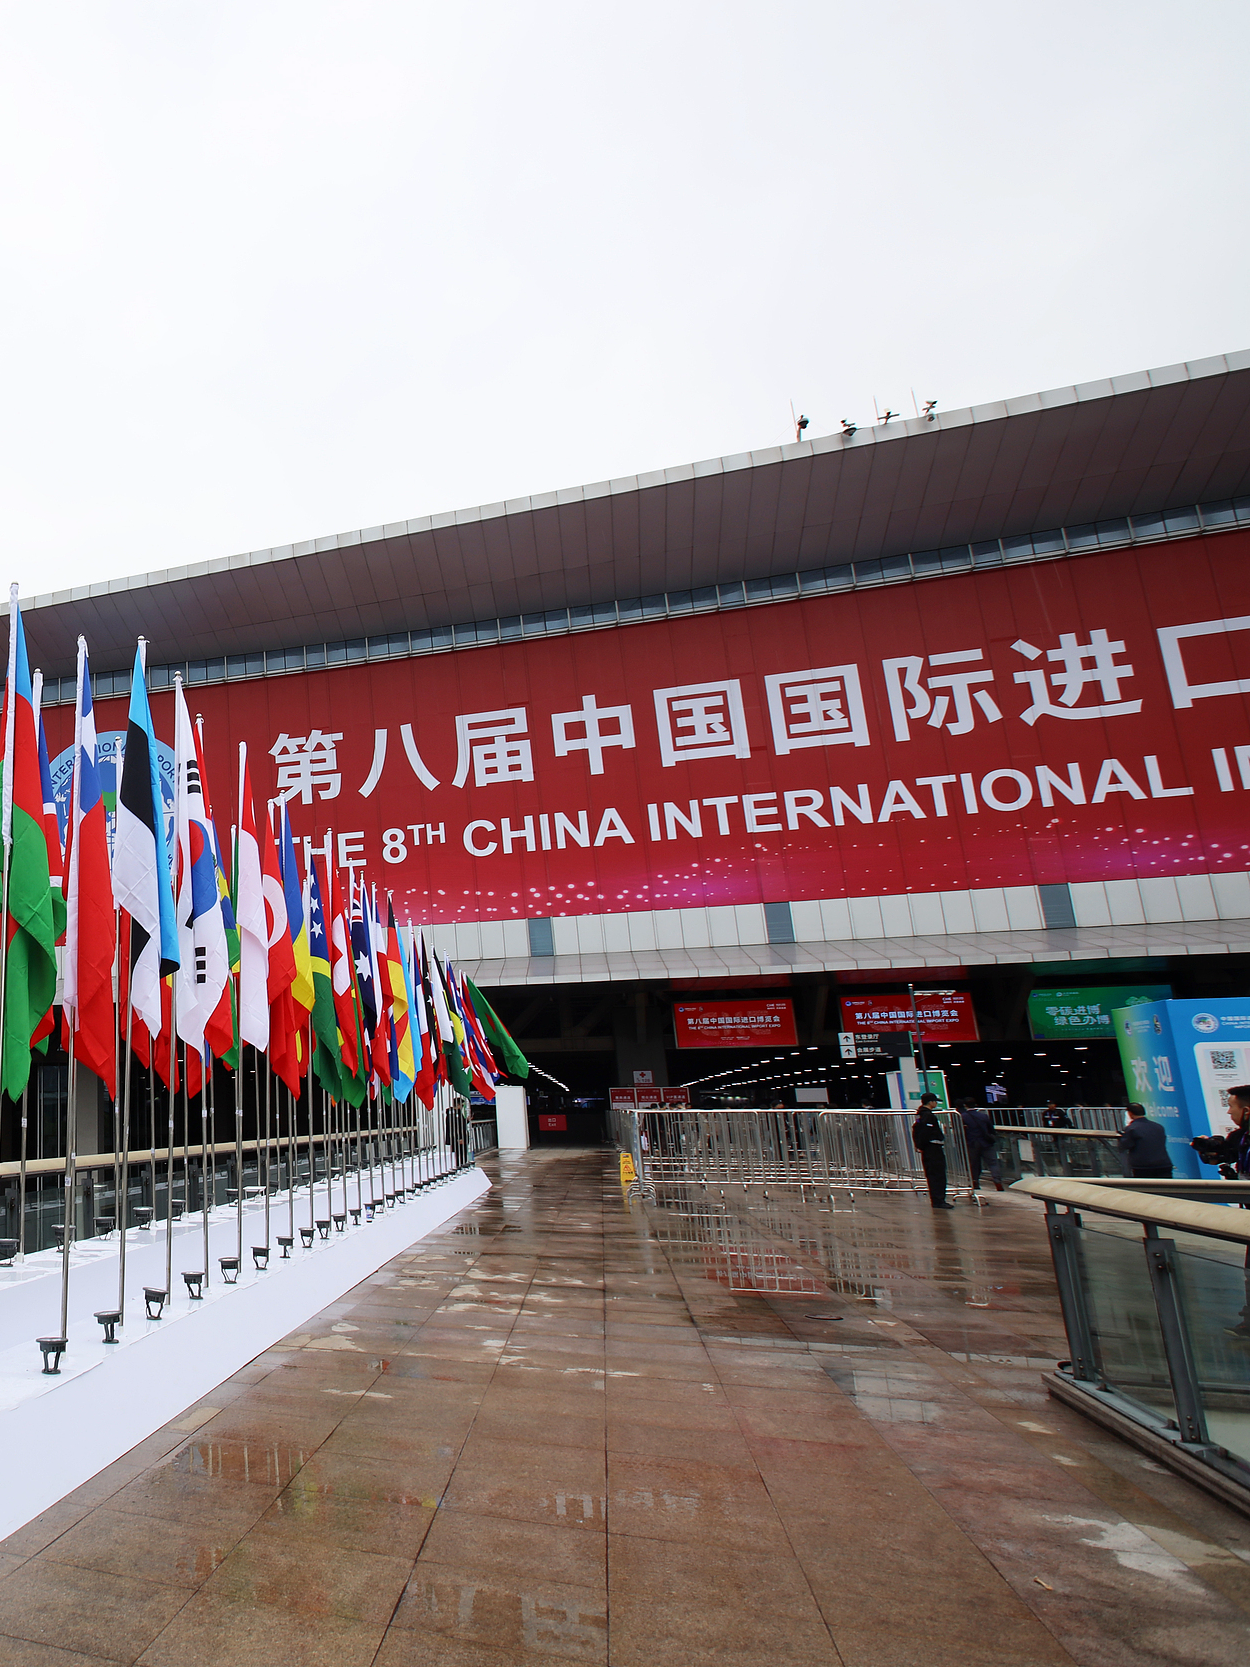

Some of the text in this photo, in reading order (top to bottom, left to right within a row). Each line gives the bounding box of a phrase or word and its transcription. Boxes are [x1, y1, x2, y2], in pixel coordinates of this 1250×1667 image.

[268, 615, 1250, 805] 第八届中国国际进口
[382, 821, 446, 864] 8TH
[462, 807, 635, 858] CHINA
[647, 755, 1195, 842] INTERNATIONAL
[687, 1015, 781, 1025] 第八届中国国际进口博览会
[1130, 1055, 1175, 1092] 欢迎
